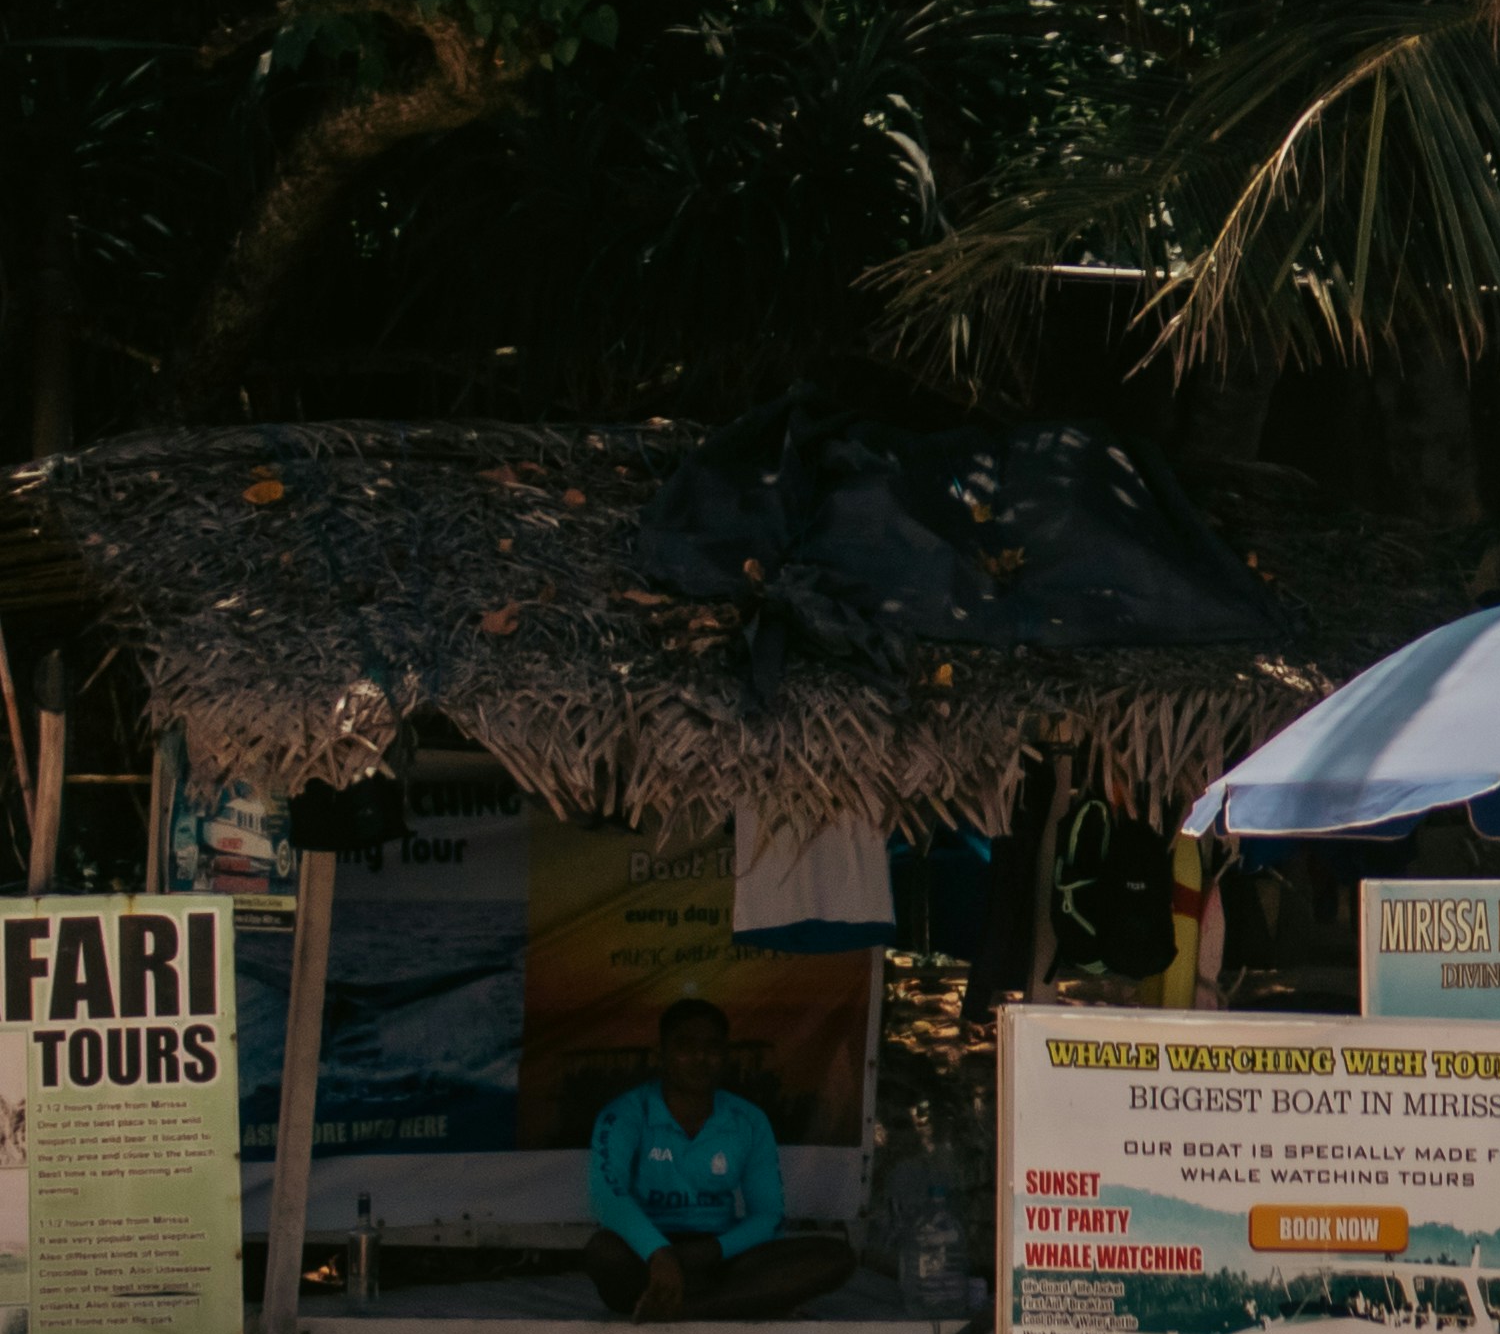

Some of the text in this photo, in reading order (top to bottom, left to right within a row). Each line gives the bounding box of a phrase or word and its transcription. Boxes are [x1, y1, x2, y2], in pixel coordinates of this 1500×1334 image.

[684, 904, 720, 925] day
[1380, 899, 1491, 953] MIRISSA
[4, 912, 217, 1021] FARI
[33, 1024, 217, 1087] TOURS
[1047, 1039, 1159, 1070] WHALE
[1165, 1044, 1336, 1075] WATCHING
[1341, 1047, 1427, 1077] WITH
[1129, 1085, 1262, 1113] BIGGEST
[1271, 1089, 1351, 1115] BOAT
[1361, 1092, 1392, 1115] IN
[400, 1115, 448, 1138] HERE
[1124, 1140, 1172, 1156] OUR
[1183, 1143, 1242, 1158] BOAT
[1252, 1143, 1273, 1159] IS
[1285, 1144, 1405, 1160] SPECIALLY
[1415, 1147, 1478, 1162] MADE
[1025, 1170, 1100, 1197] SUNSET
[1180, 1167, 1475, 1187] WHALE WATCHING TOURS
[1025, 1205, 1130, 1234] YOT PARTY
[1279, 1217, 1379, 1242] BOOK NOW
[1025, 1242, 1203, 1273] WHALE WATCHING
